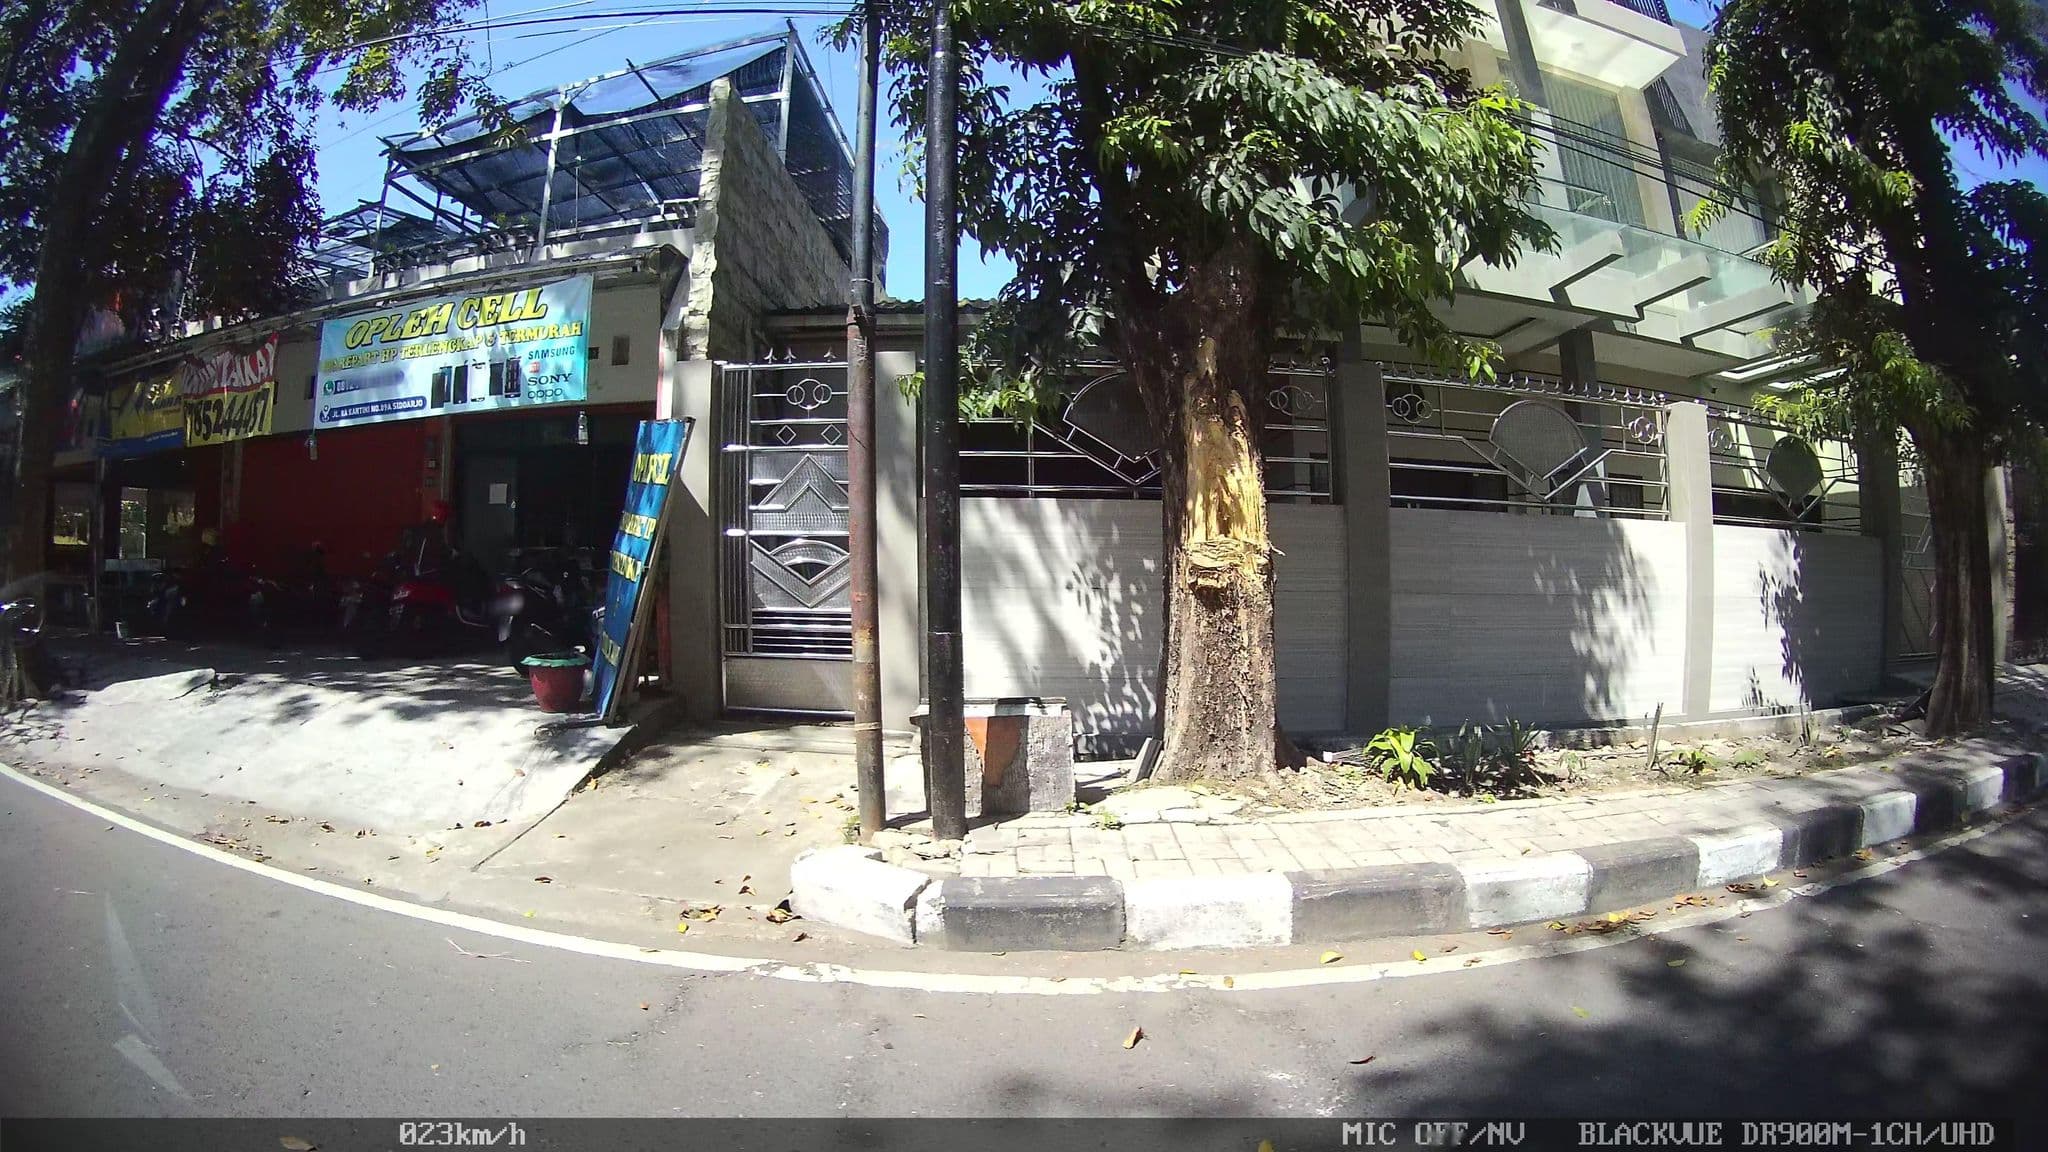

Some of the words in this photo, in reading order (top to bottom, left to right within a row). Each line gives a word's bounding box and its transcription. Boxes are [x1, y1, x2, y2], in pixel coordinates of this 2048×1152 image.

[345, 302, 456, 349] OPLEH
[457, 287, 548, 330] CELL
[401, 334, 483, 360] TERLENGKAP
[500, 322, 584, 345] TERMURAH
[528, 346, 575, 360] SAMSUNG
[528, 373, 573, 386] SONY
[393, 399, 424, 411] SIDOARJO
